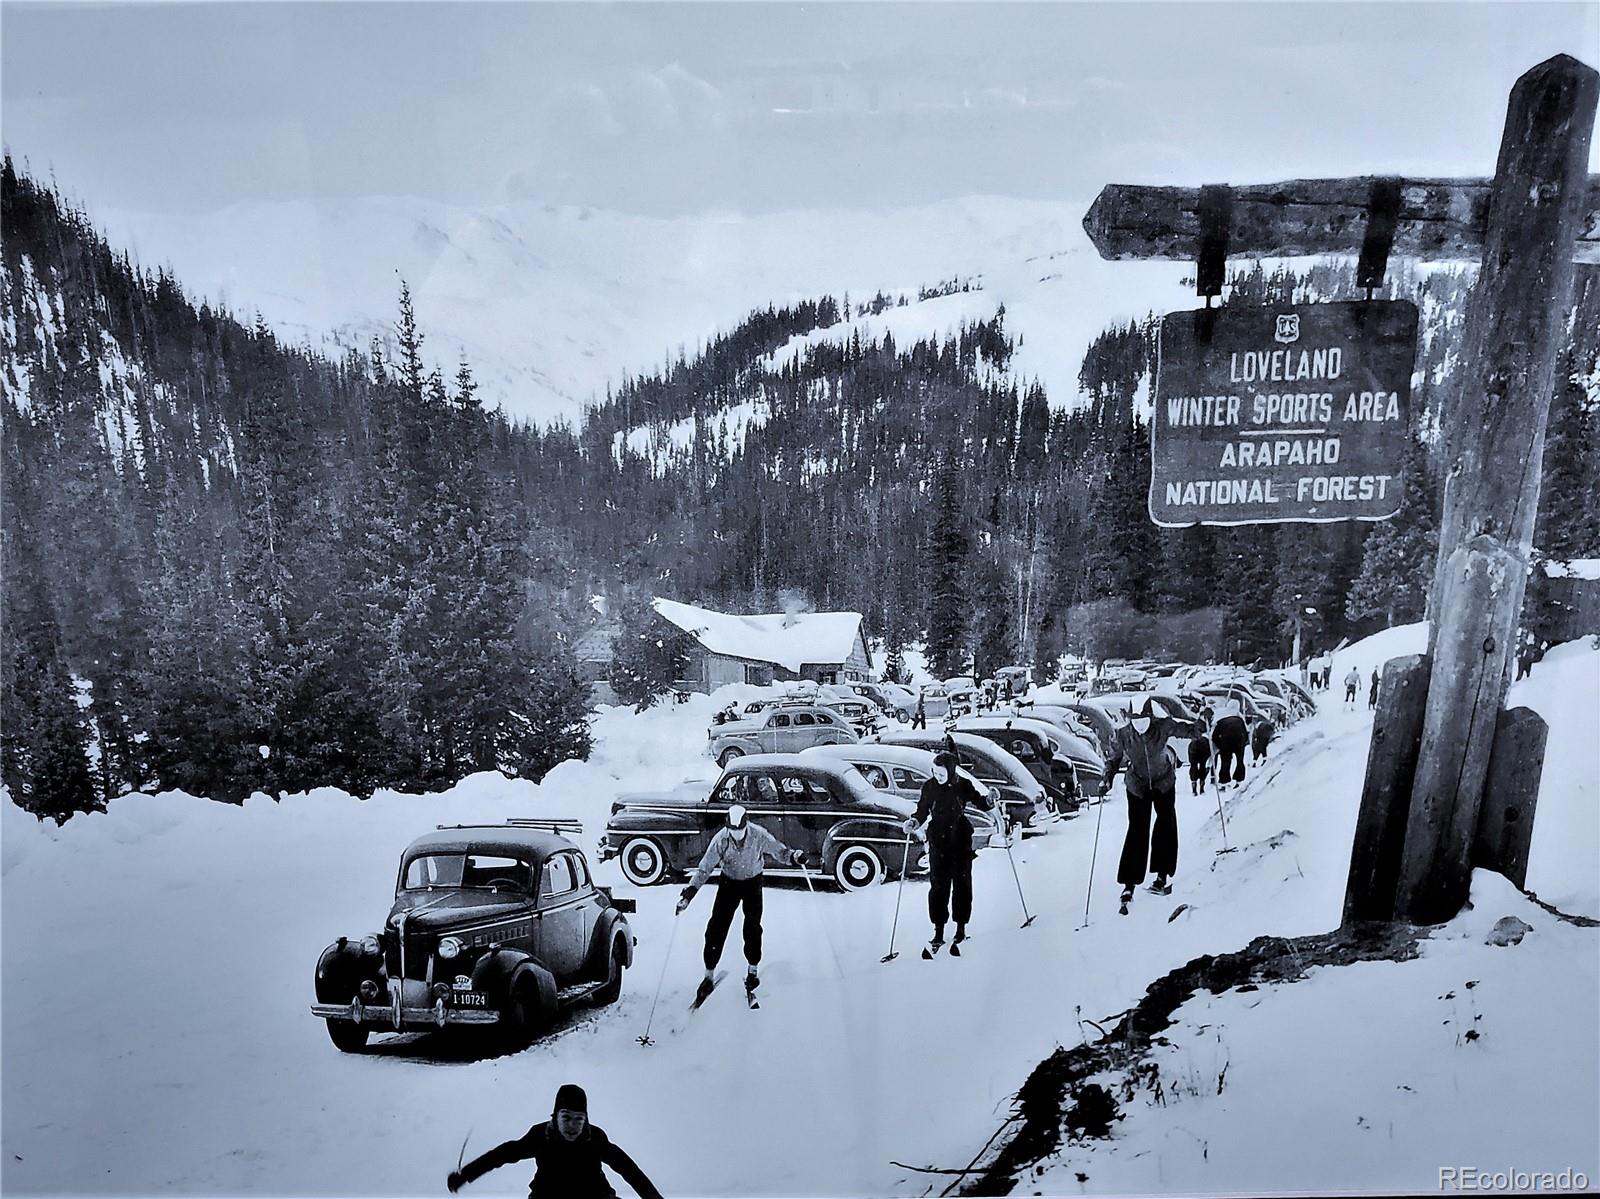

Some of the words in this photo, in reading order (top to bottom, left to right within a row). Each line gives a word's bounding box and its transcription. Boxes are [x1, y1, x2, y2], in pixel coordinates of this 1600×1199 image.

[1230, 348, 1342, 383] LOVELAND
[1167, 395, 1240, 426] WINTER
[1252, 393, 1333, 424] SPORTS
[1343, 391, 1400, 422] AREA
[1219, 438, 1340, 468] ARAPAHO
[1165, 479, 1279, 506] NATIONAL
[1297, 475, 1392, 502] FOREST
